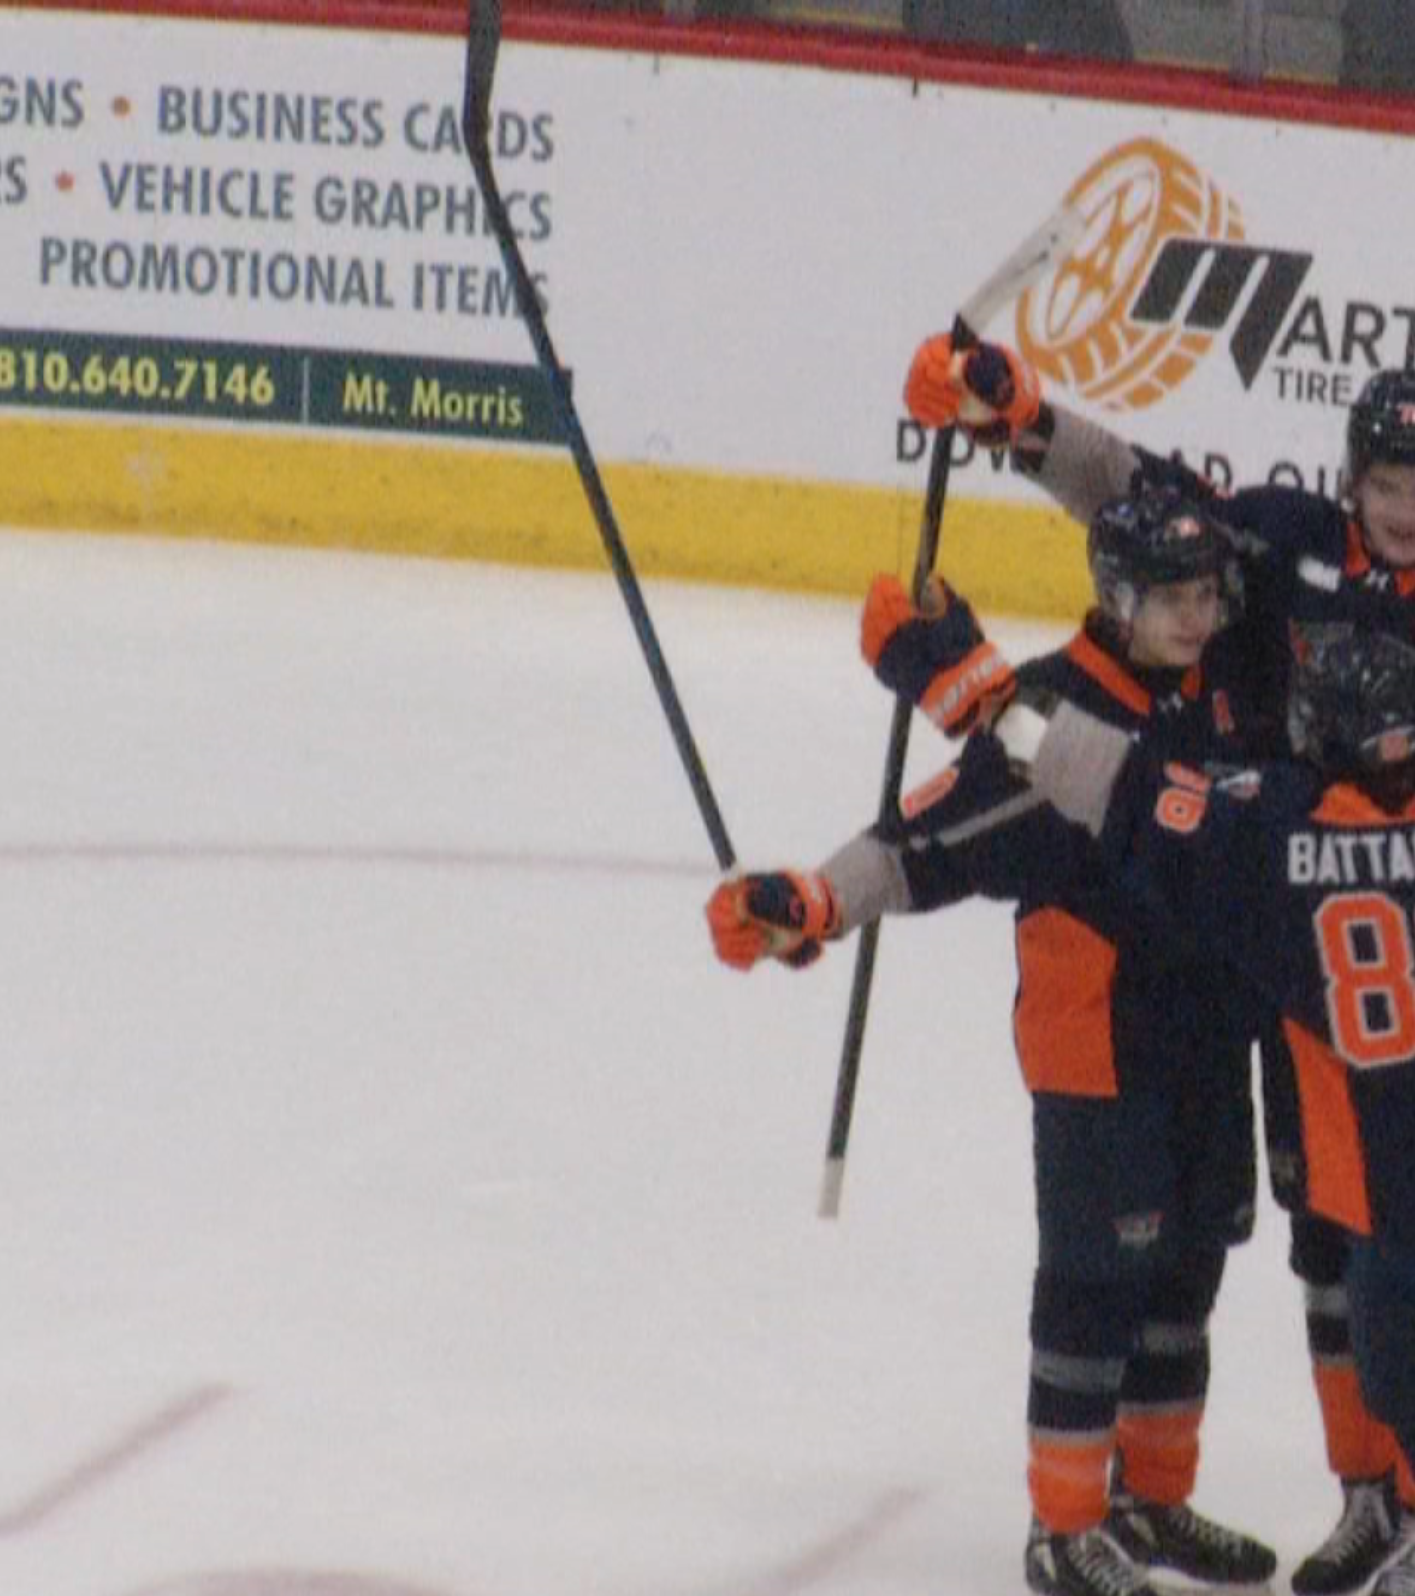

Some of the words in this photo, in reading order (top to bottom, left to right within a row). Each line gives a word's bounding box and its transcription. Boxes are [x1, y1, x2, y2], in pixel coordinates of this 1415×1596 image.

[158, 84, 385, 149] BUSINESS
[403, 102, 554, 163] CADS
[99, 162, 294, 221] VEHICLE
[39, 237, 394, 309] PROMOTIONAL
[0, 347, 275, 404] 810.640.7146
[343, 374, 396, 415] Mt.
[410, 379, 524, 425] Morris
[1272, 366, 1354, 406] TIRE
